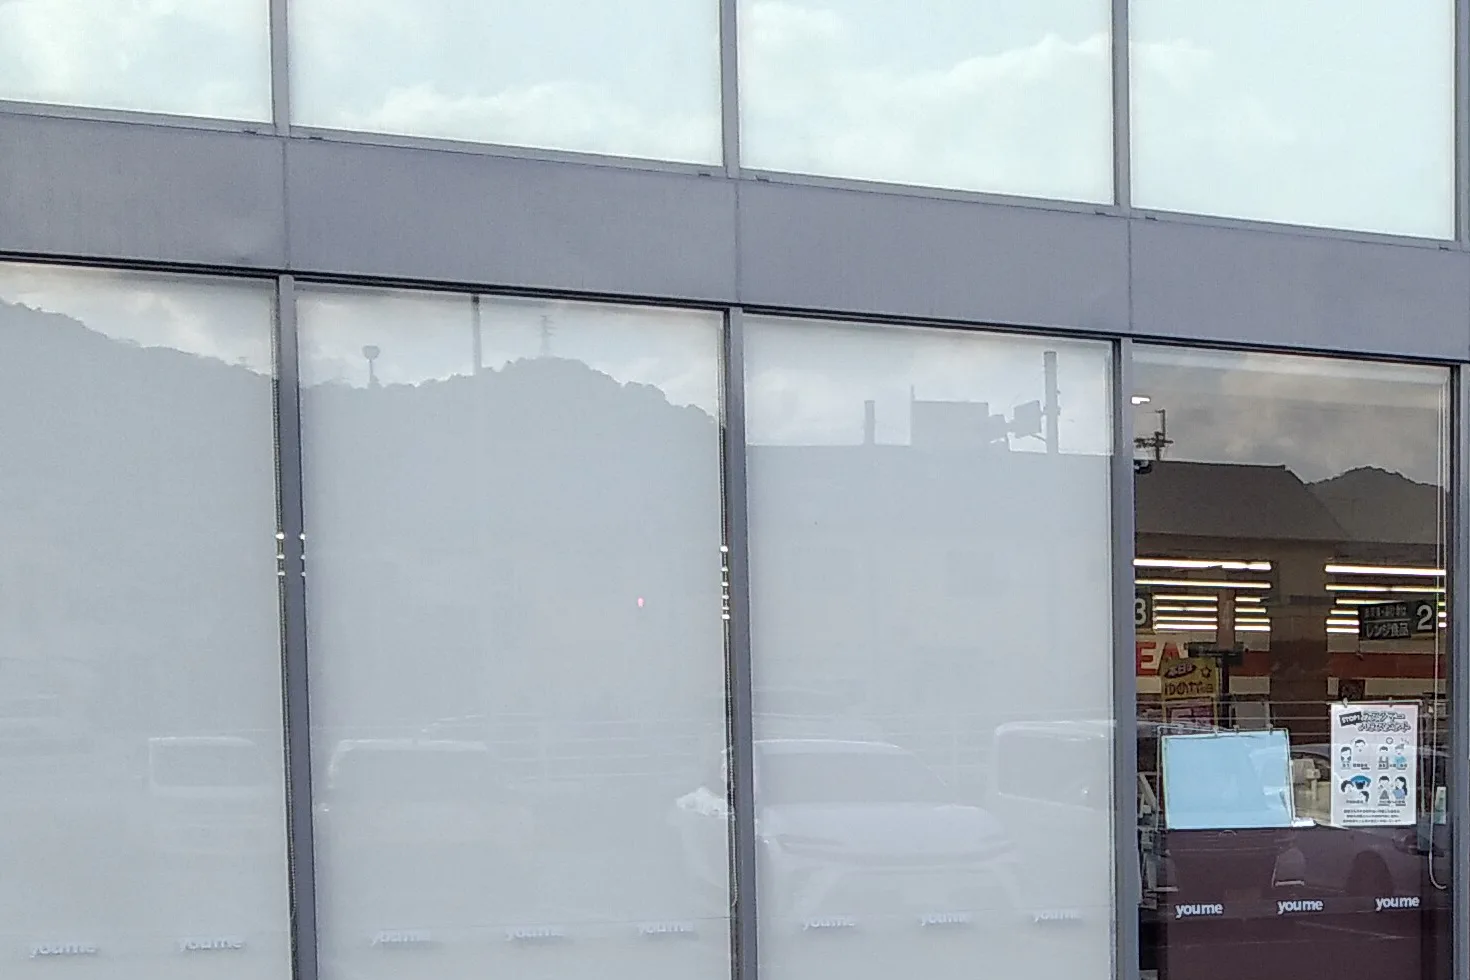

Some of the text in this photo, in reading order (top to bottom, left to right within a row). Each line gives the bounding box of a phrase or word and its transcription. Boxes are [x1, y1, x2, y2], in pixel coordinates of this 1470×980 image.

[1416, 604, 1434, 631] 2
[1175, 902, 1224, 919] youme
[1277, 900, 1324, 914] youme
[1375, 896, 1420, 911] youme
